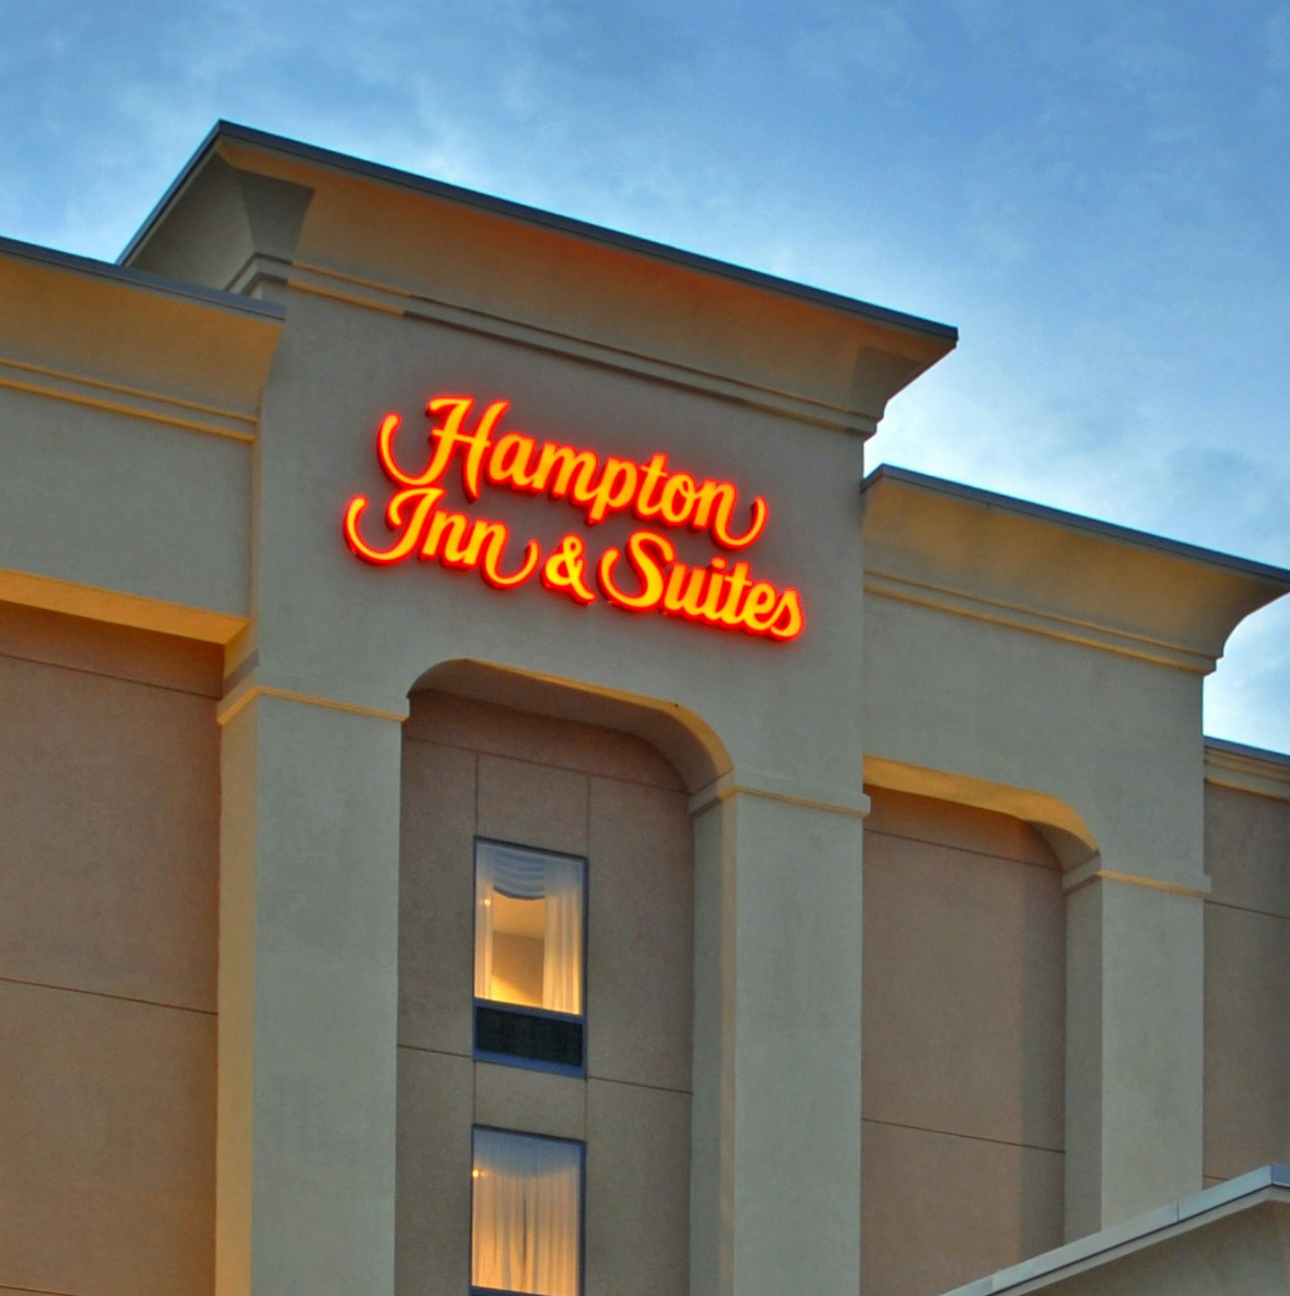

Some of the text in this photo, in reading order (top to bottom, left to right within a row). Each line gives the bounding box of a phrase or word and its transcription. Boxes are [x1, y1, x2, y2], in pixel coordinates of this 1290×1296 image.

[376, 396, 769, 552] Hampton
[343, 486, 805, 642] Inn & Suites
